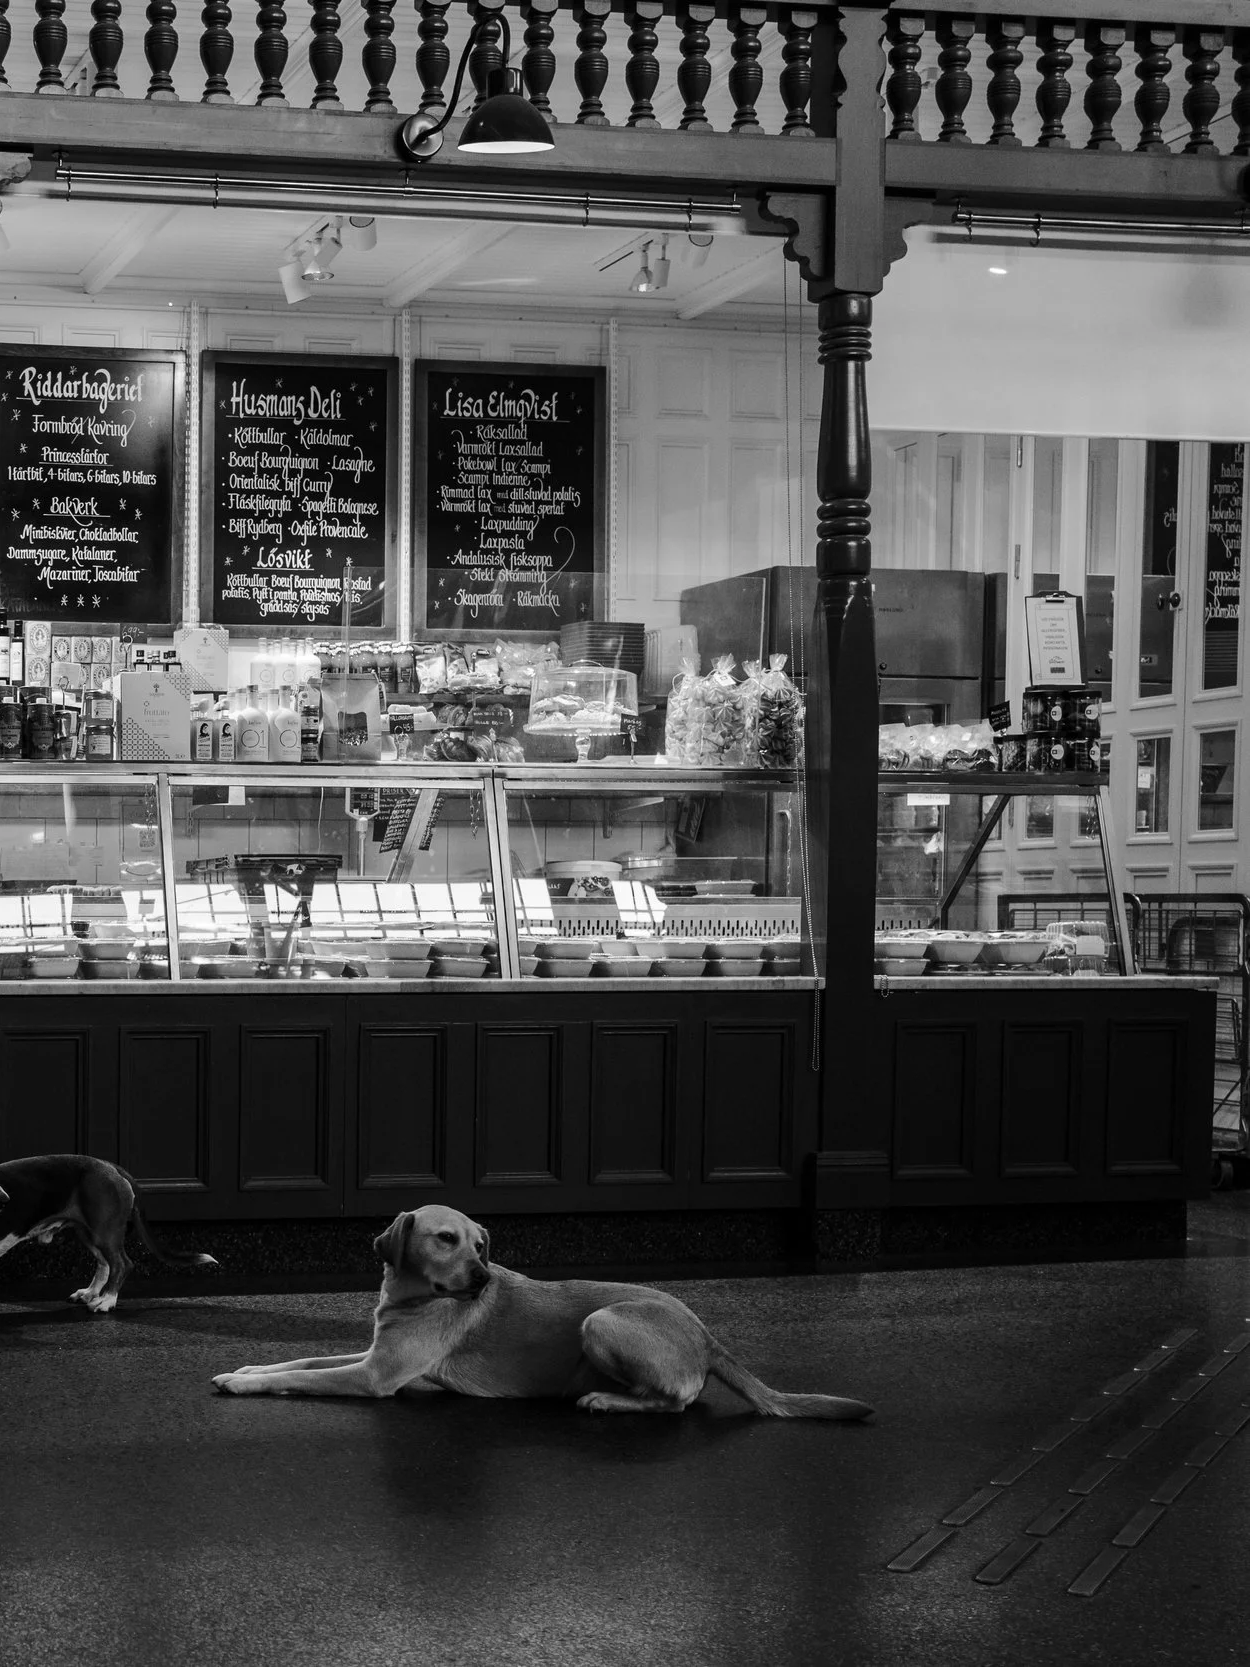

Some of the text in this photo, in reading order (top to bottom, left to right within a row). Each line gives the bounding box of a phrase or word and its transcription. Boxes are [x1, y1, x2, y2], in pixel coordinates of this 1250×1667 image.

[231, 378, 341, 425] Husmans Deli
[443, 388, 558, 430] Lisa Elmqvist
[234, 427, 287, 449] Köttbullar
[499, 441, 543, 456] Laxsallad
[41, 446, 110, 465] Princesstårtor
[228, 445, 319, 480] Boeuf Bourguignon
[332, 446, 375, 484] Lasagne
[457, 456, 497, 471] Pokebowl
[122, 470, 157, 485] 10-bitars
[229, 473, 282, 491] Orientalisk
[303, 471, 333, 501] Curry
[457, 471, 530, 488] Scampi Indienne
[441, 485, 475, 502] Rimmad
[478, 485, 496, 504] lax
[553, 486, 581, 507] potatis
[50, 496, 100, 526] Bakverk
[338, 498, 379, 524] Bolognese
[478, 500, 493, 516] lax
[508, 501, 535, 514] stuvad
[79, 527, 139, 543] Chokladbollar,
[229, 518, 247, 538] Biff
[247, 519, 282, 544] Rydberg
[481, 515, 539, 541] Laxpudding
[480, 532, 525, 553] Laxpasta
[6, 545, 118, 567] Dammsugare, Katalaner,
[257, 546, 313, 569] Lösvikt
[451, 549, 553, 572] Andalusisk fisksoppa
[37, 565, 140, 589] Mazariner, Toscabitar
[470, 567, 494, 582] Stekt
